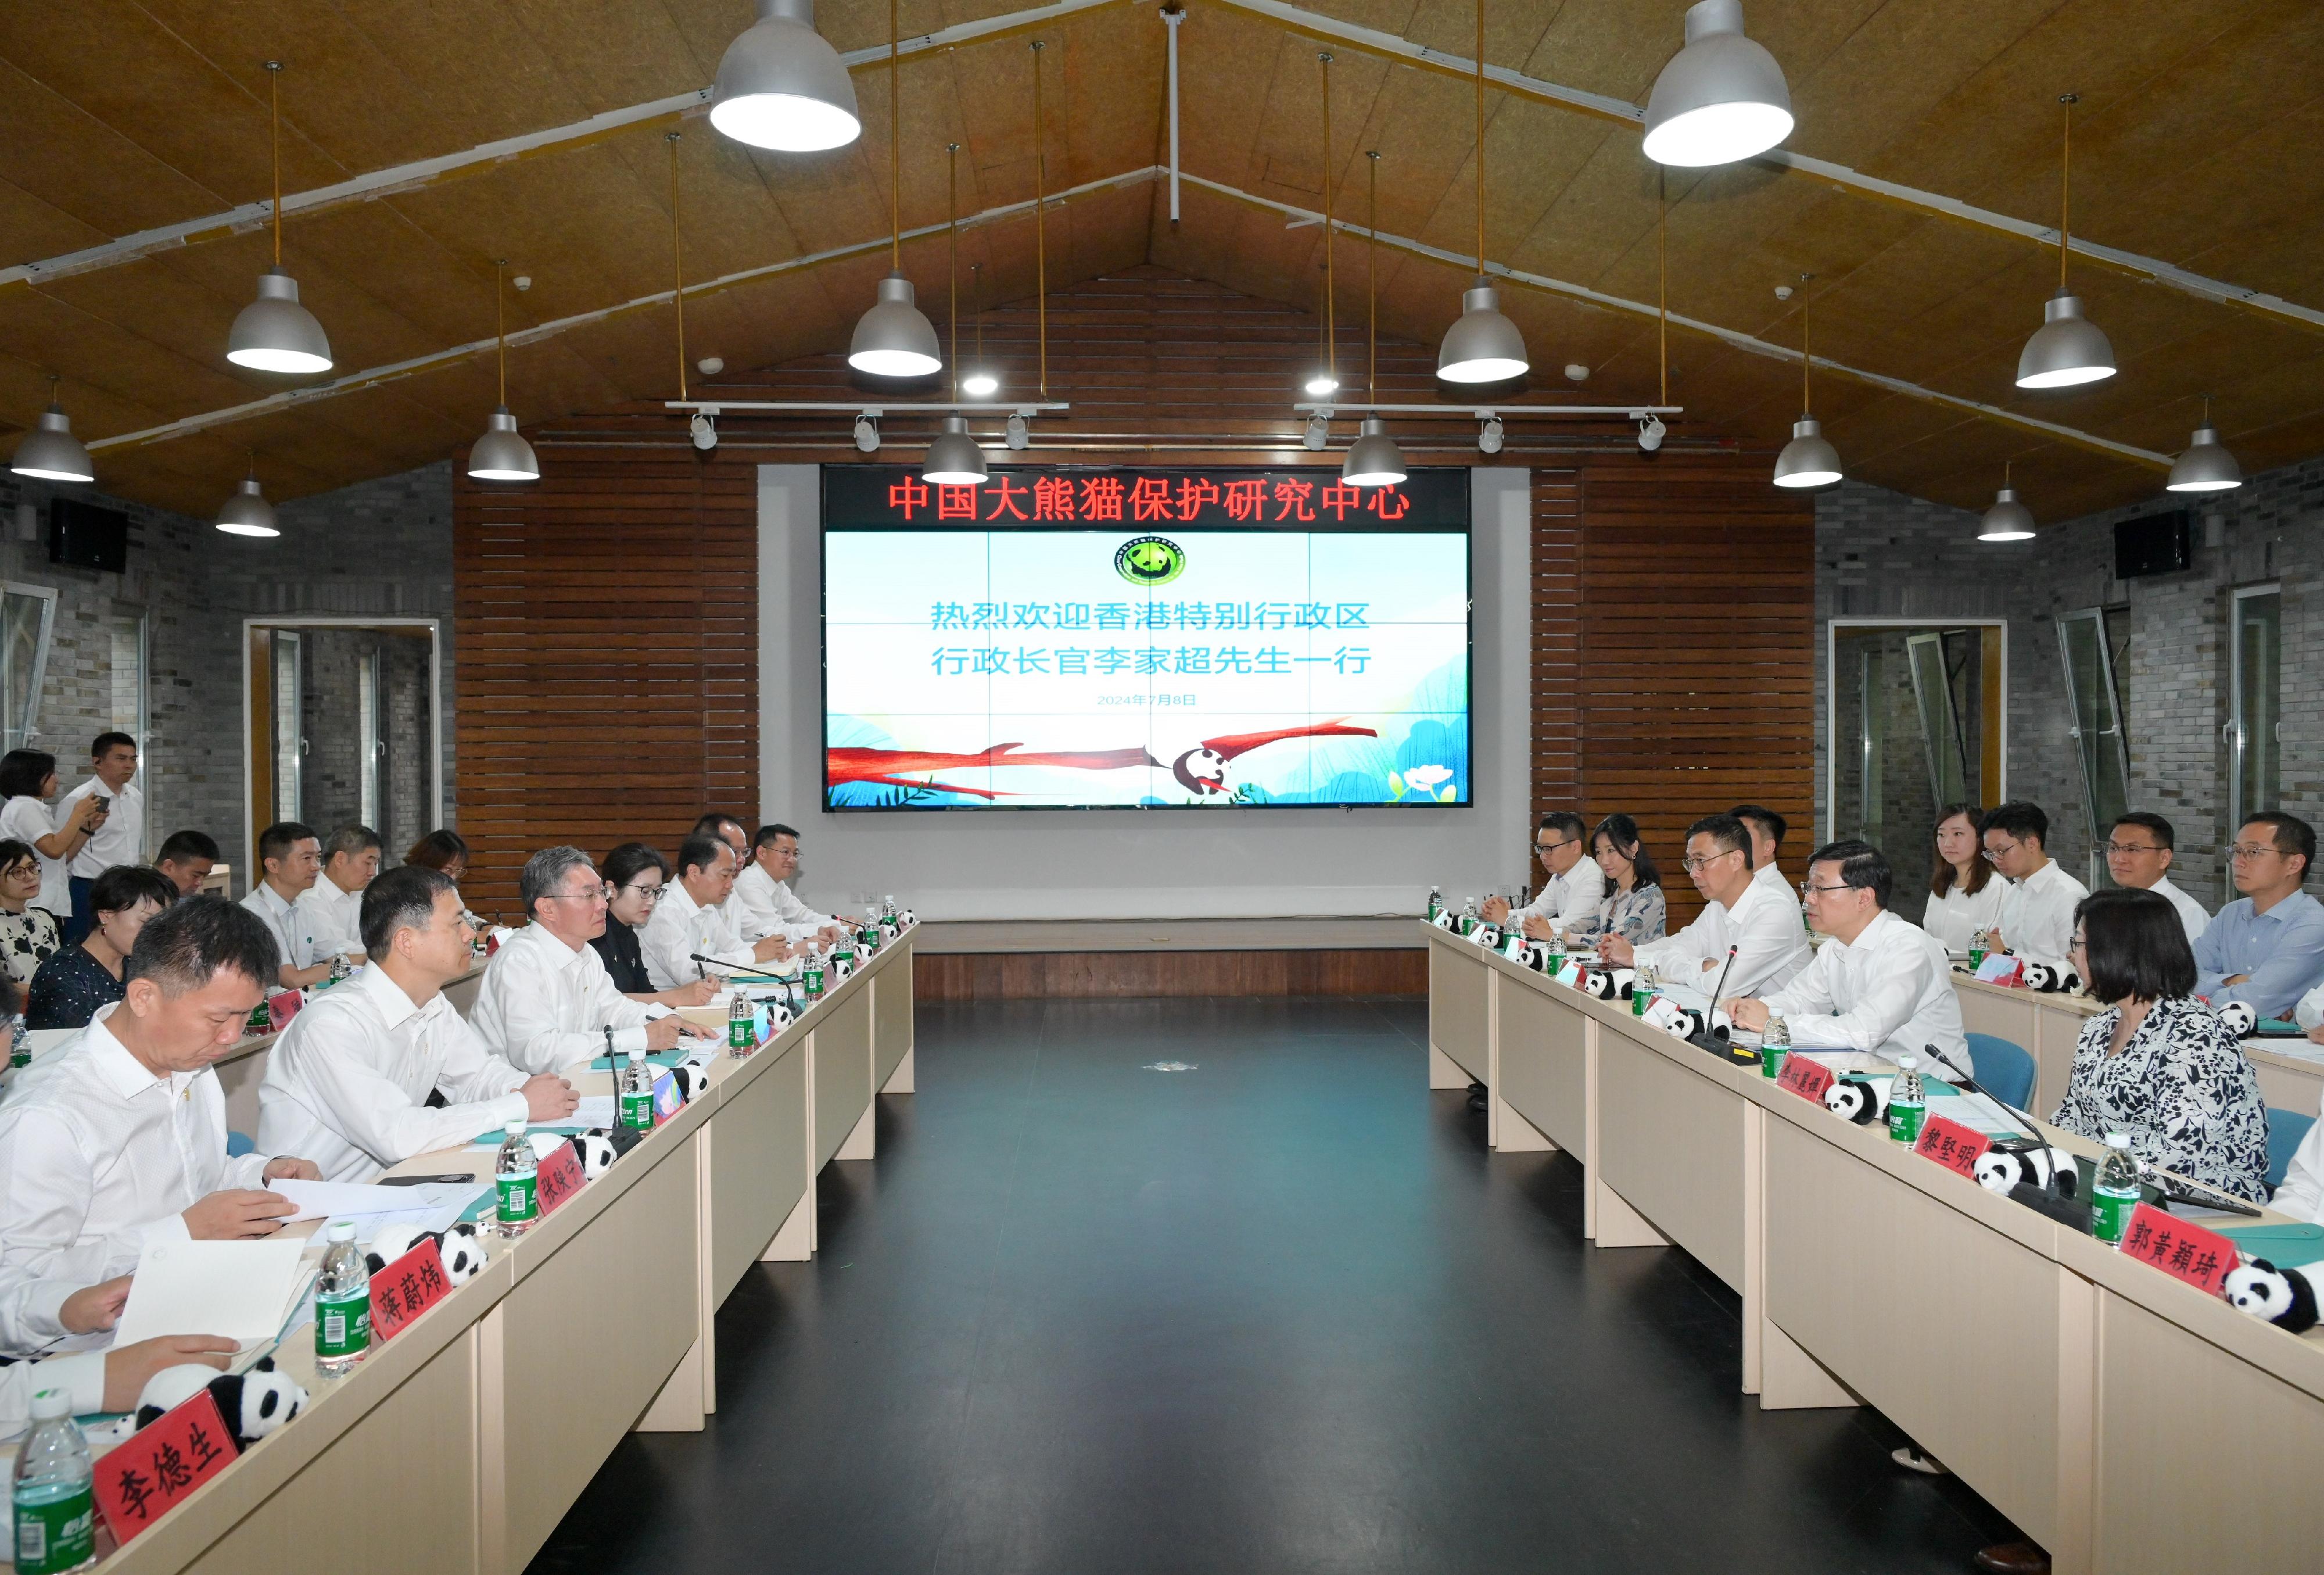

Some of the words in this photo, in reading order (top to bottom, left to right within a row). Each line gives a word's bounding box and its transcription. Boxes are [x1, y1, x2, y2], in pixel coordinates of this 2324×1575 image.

[889, 476, 1410, 521] 中国大熊猫保护研究中心
[930, 601, 1370, 631] 热烈欢迎香港特别行政区
[931, 645, 1372, 676] 行政长官李家超先生一行
[1097, 694, 1197, 707] 2024年7月8日
[1922, 1127, 1977, 1171] 黎堅明
[378, 1259, 441, 1327] 蒋蔚炜
[119, 1422, 223, 1519] 李德生
